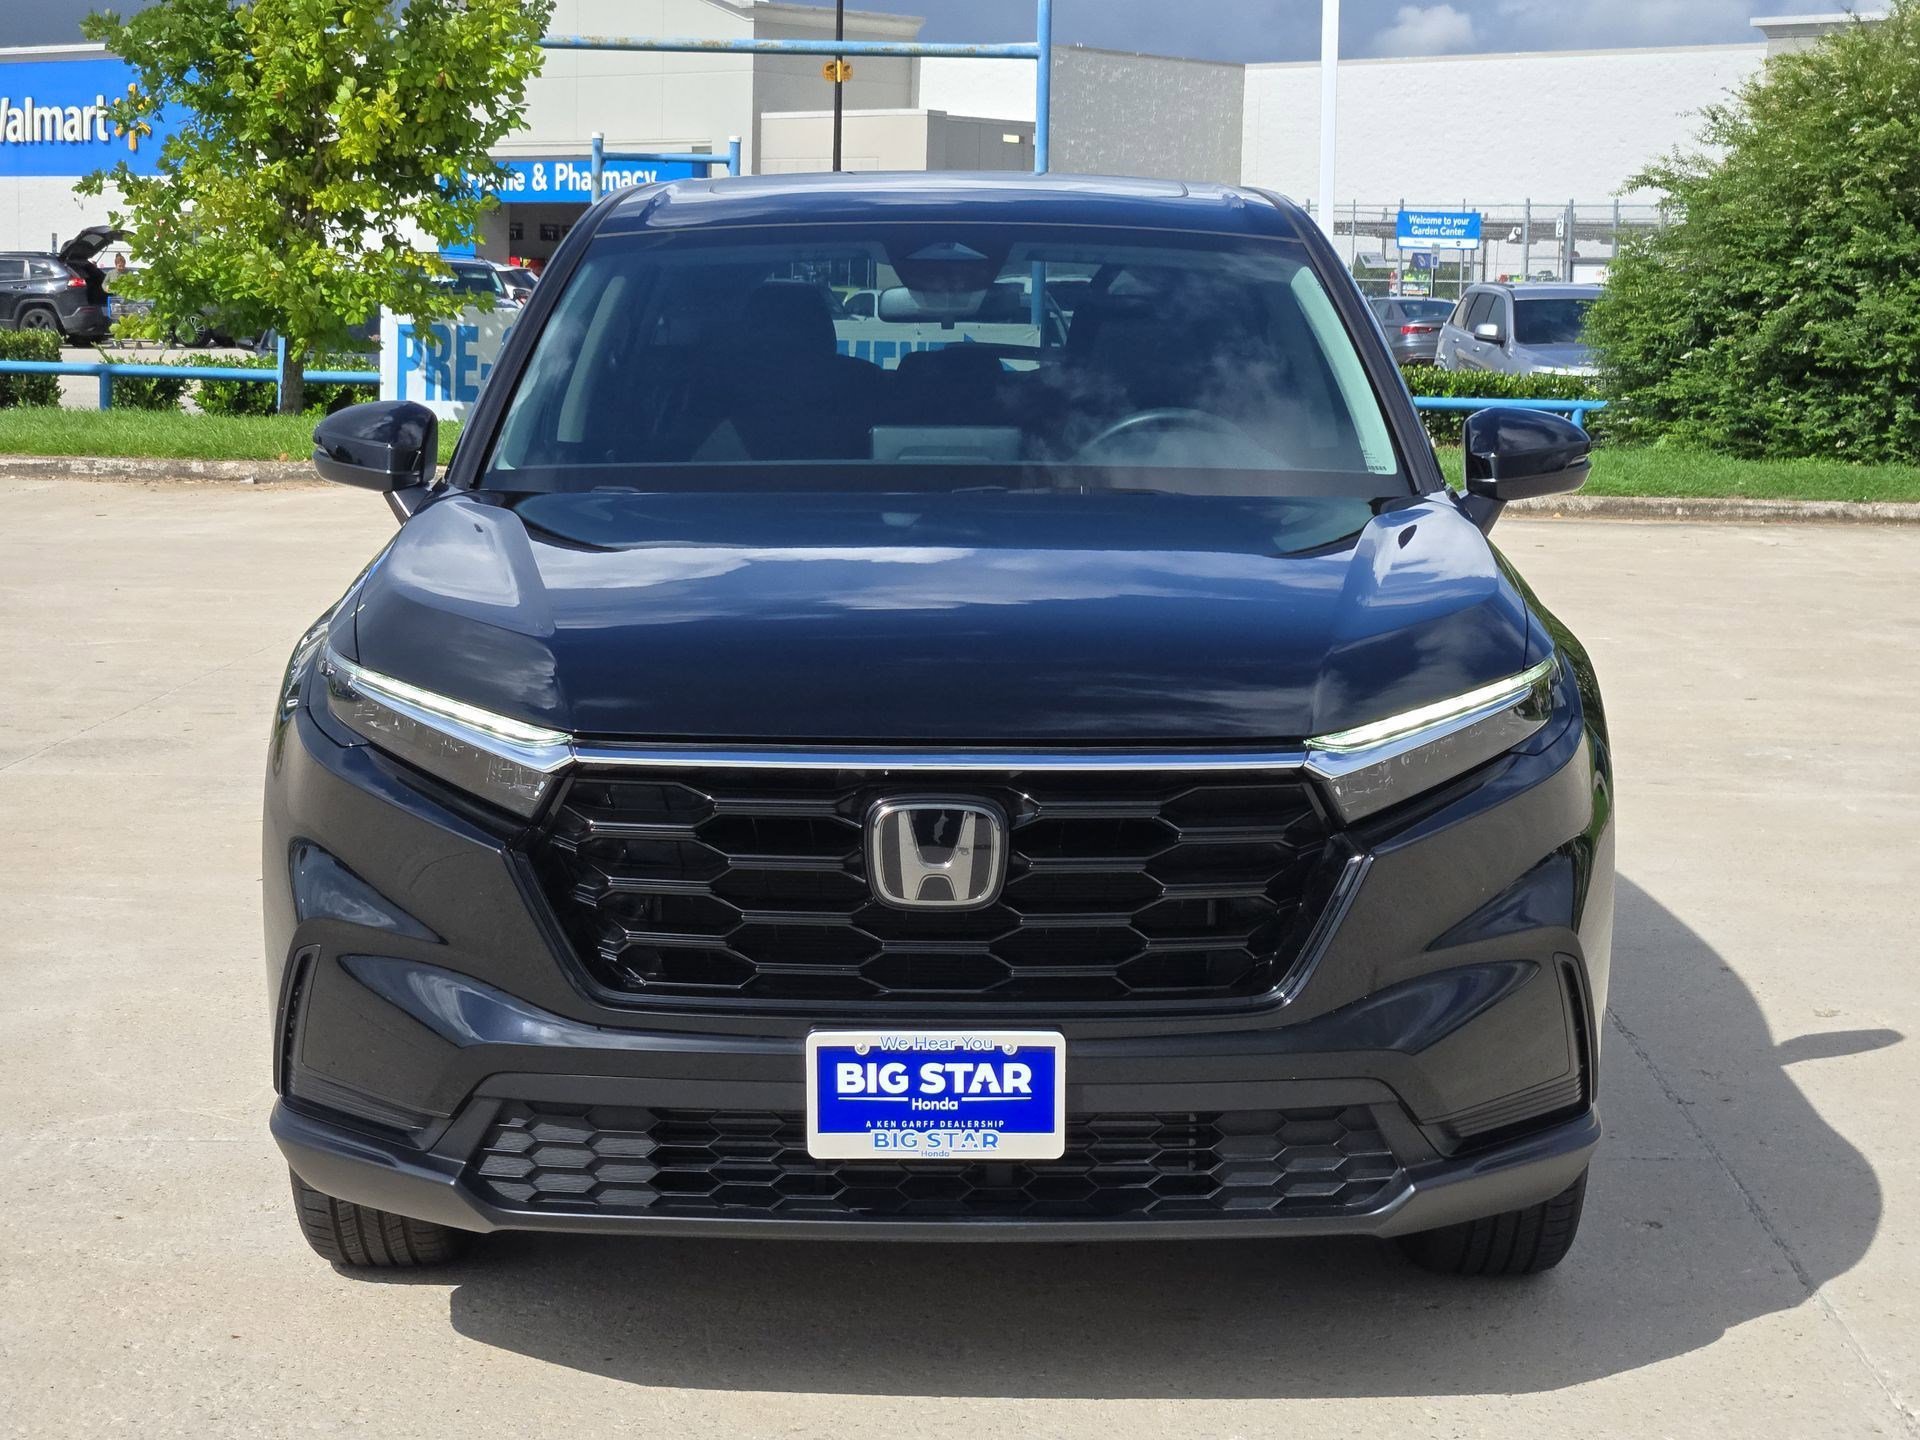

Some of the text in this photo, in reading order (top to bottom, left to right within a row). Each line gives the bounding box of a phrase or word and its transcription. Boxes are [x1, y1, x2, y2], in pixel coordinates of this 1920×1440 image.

[0, 95, 108, 142] almart
[532, 163, 548, 191] &
[555, 163, 657, 191] Phamacy
[1409, 214, 1470, 227] Welcome to your
[1411, 226, 1466, 236] Garden Center
[397, 324, 512, 402] PRE-
[881, 1036, 993, 1049] We Hear You
[837, 1062, 1032, 1094] BIG STAR
[911, 1097, 958, 1111] Honda
[866, 1120, 1004, 1128] A KEN GARFF DEALERSHIP
[874, 1133, 999, 1148] BIG STAR
